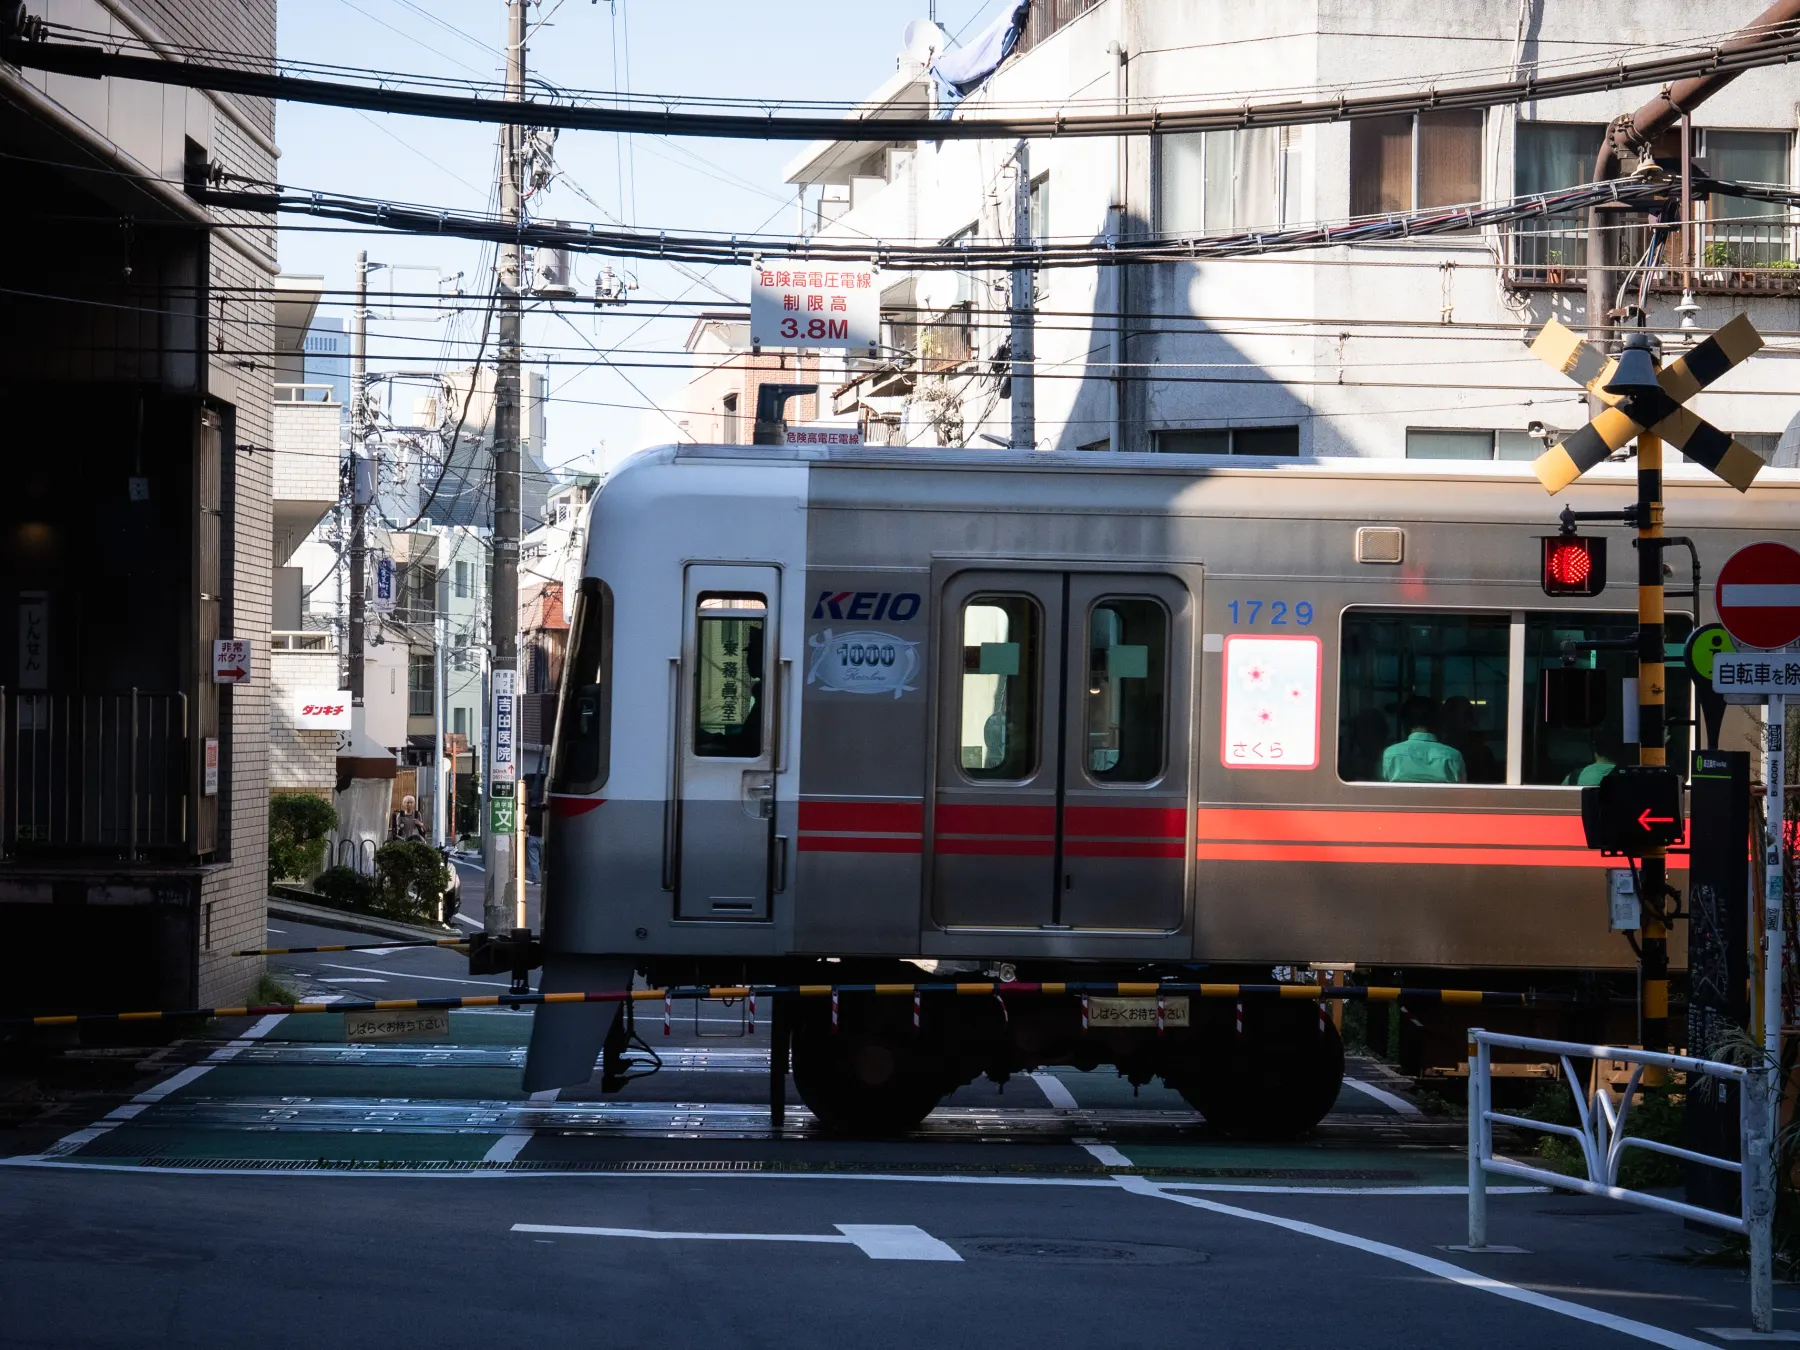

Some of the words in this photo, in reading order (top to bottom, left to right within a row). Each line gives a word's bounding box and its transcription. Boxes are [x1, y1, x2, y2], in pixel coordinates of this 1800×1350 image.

[760, 270, 871, 289] 危険高電圧電線
[784, 294, 847, 312] 制限高
[780, 318, 848, 339] 3.8M
[786, 432, 859, 444] 危険高電圧電線
[812, 591, 921, 621] KEIO
[1228, 600, 1314, 626] 1729
[221, 642, 243, 652] 非常
[837, 643, 895, 667] 1000
[218, 653, 247, 663] ボタン
[721, 640, 738, 722] 乗務員室
[302, 704, 344, 716] ダンキチ
[497, 697, 512, 762] 吉田医院
[1232, 741, 1284, 759] さくら
[1091, 1007, 1186, 1020] しばらくお待ちさい
[348, 1018, 445, 1036] しばらくお待ち下さい
